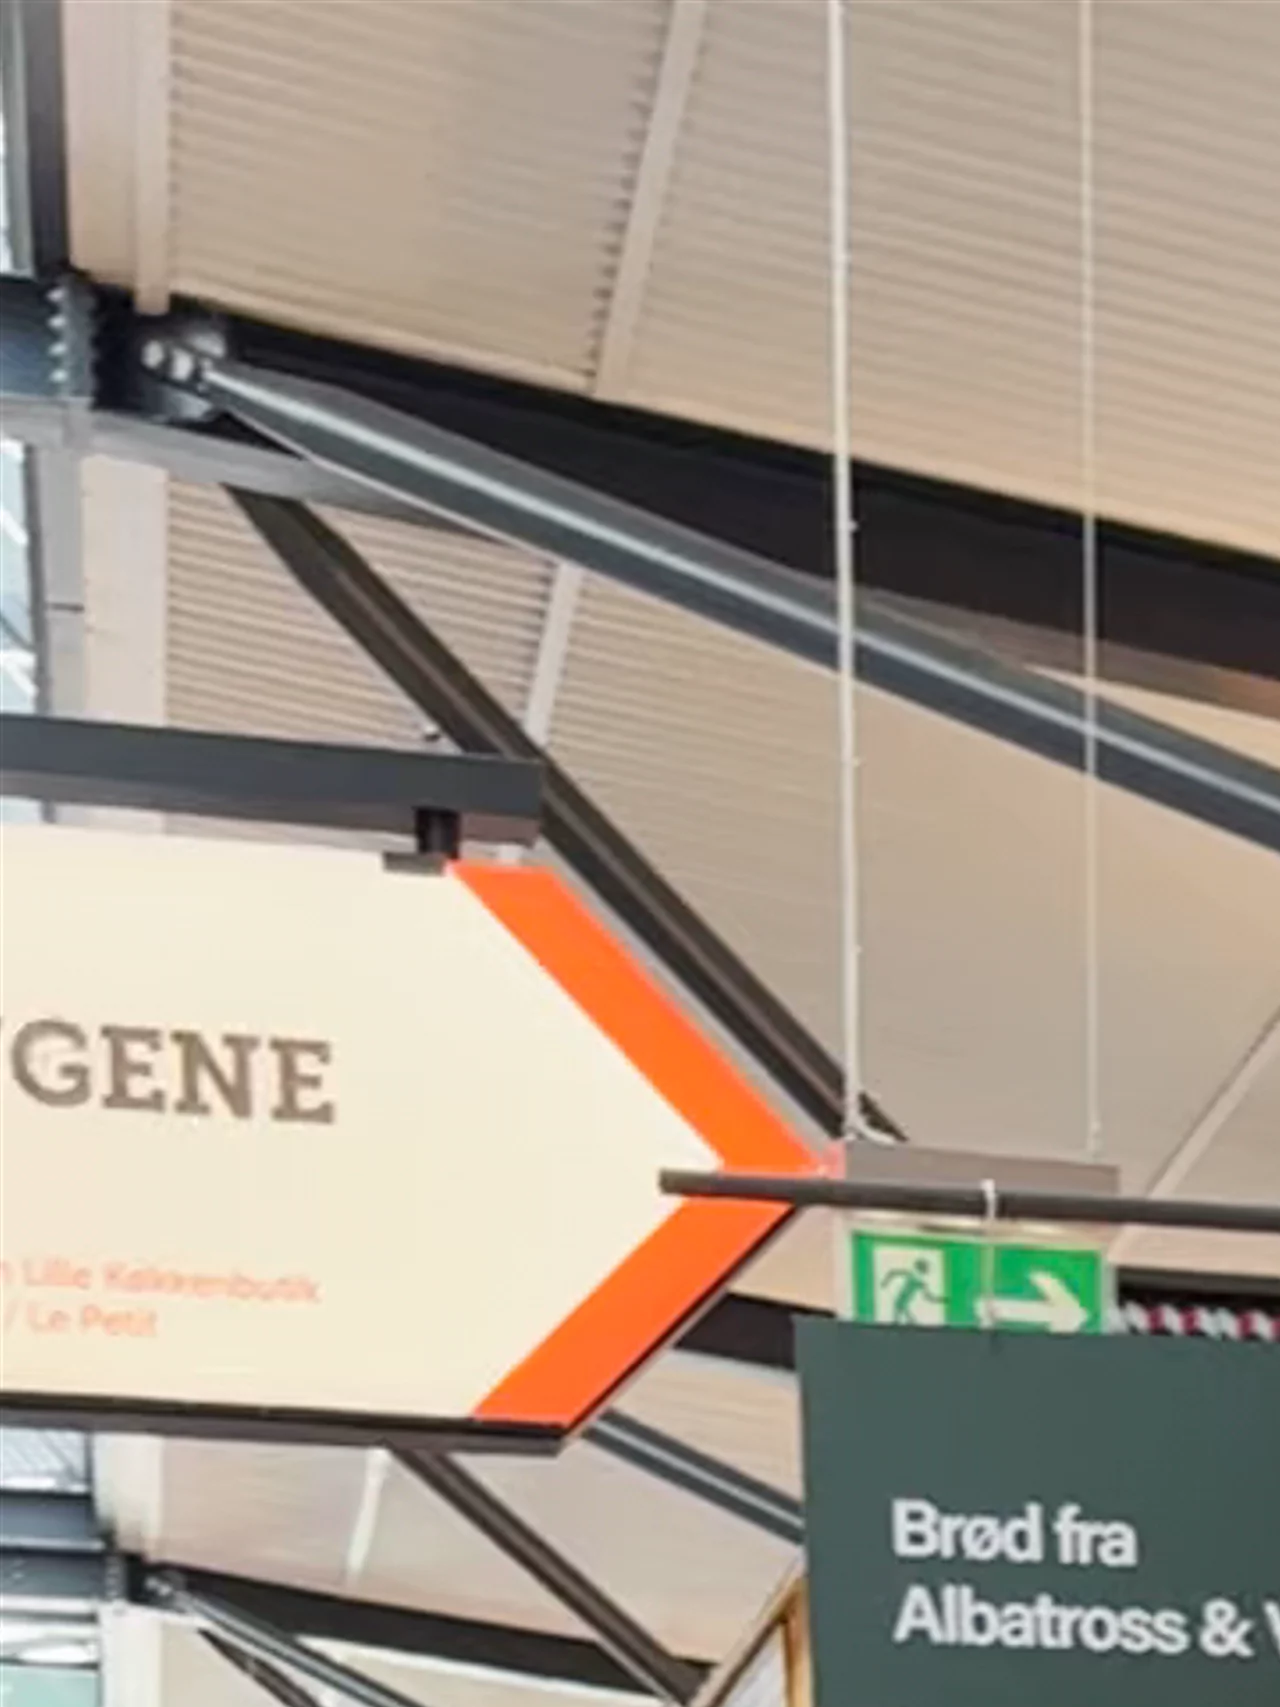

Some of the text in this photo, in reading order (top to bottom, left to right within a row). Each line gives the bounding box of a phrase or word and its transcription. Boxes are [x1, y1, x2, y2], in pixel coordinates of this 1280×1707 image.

[0, 1016, 334, 1124] GENE
[23, 1257, 92, 1290] Lille
[26, 1301, 70, 1332] Le
[81, 1304, 158, 1337] Petit
[891, 1498, 1139, 1567] Brød fra
[893, 1584, 1190, 1655] Albatross
[1200, 1601, 1253, 1658] &
